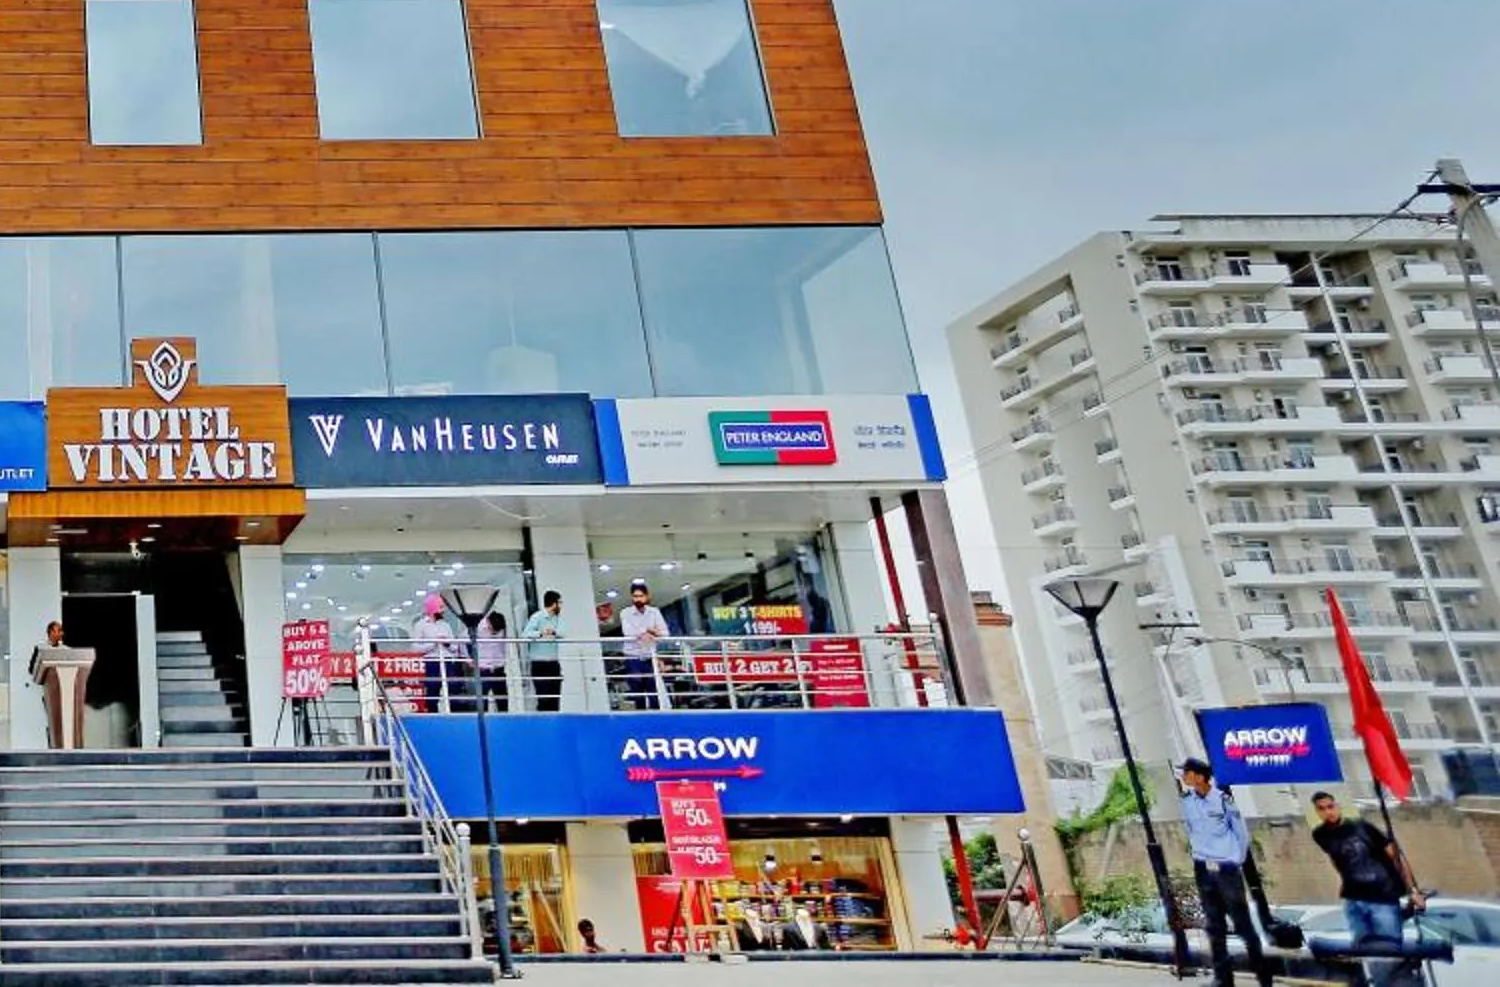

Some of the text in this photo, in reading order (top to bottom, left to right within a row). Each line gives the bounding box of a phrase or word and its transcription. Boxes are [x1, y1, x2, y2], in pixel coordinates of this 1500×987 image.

[99, 406, 240, 442] HOTEL
[725, 430, 823, 445] PETER ENGLAND
[63, 441, 278, 483] VINTAGE
[287, 639, 325, 651] ABOVE
[291, 654, 321, 666] FLAT
[395, 658, 426, 674] FREE
[735, 658, 747, 674] 2
[782, 658, 795, 674] 2
[284, 668, 329, 695] 50%
[1224, 725, 1308, 748] ARROW
[621, 736, 759, 761] ARROW
